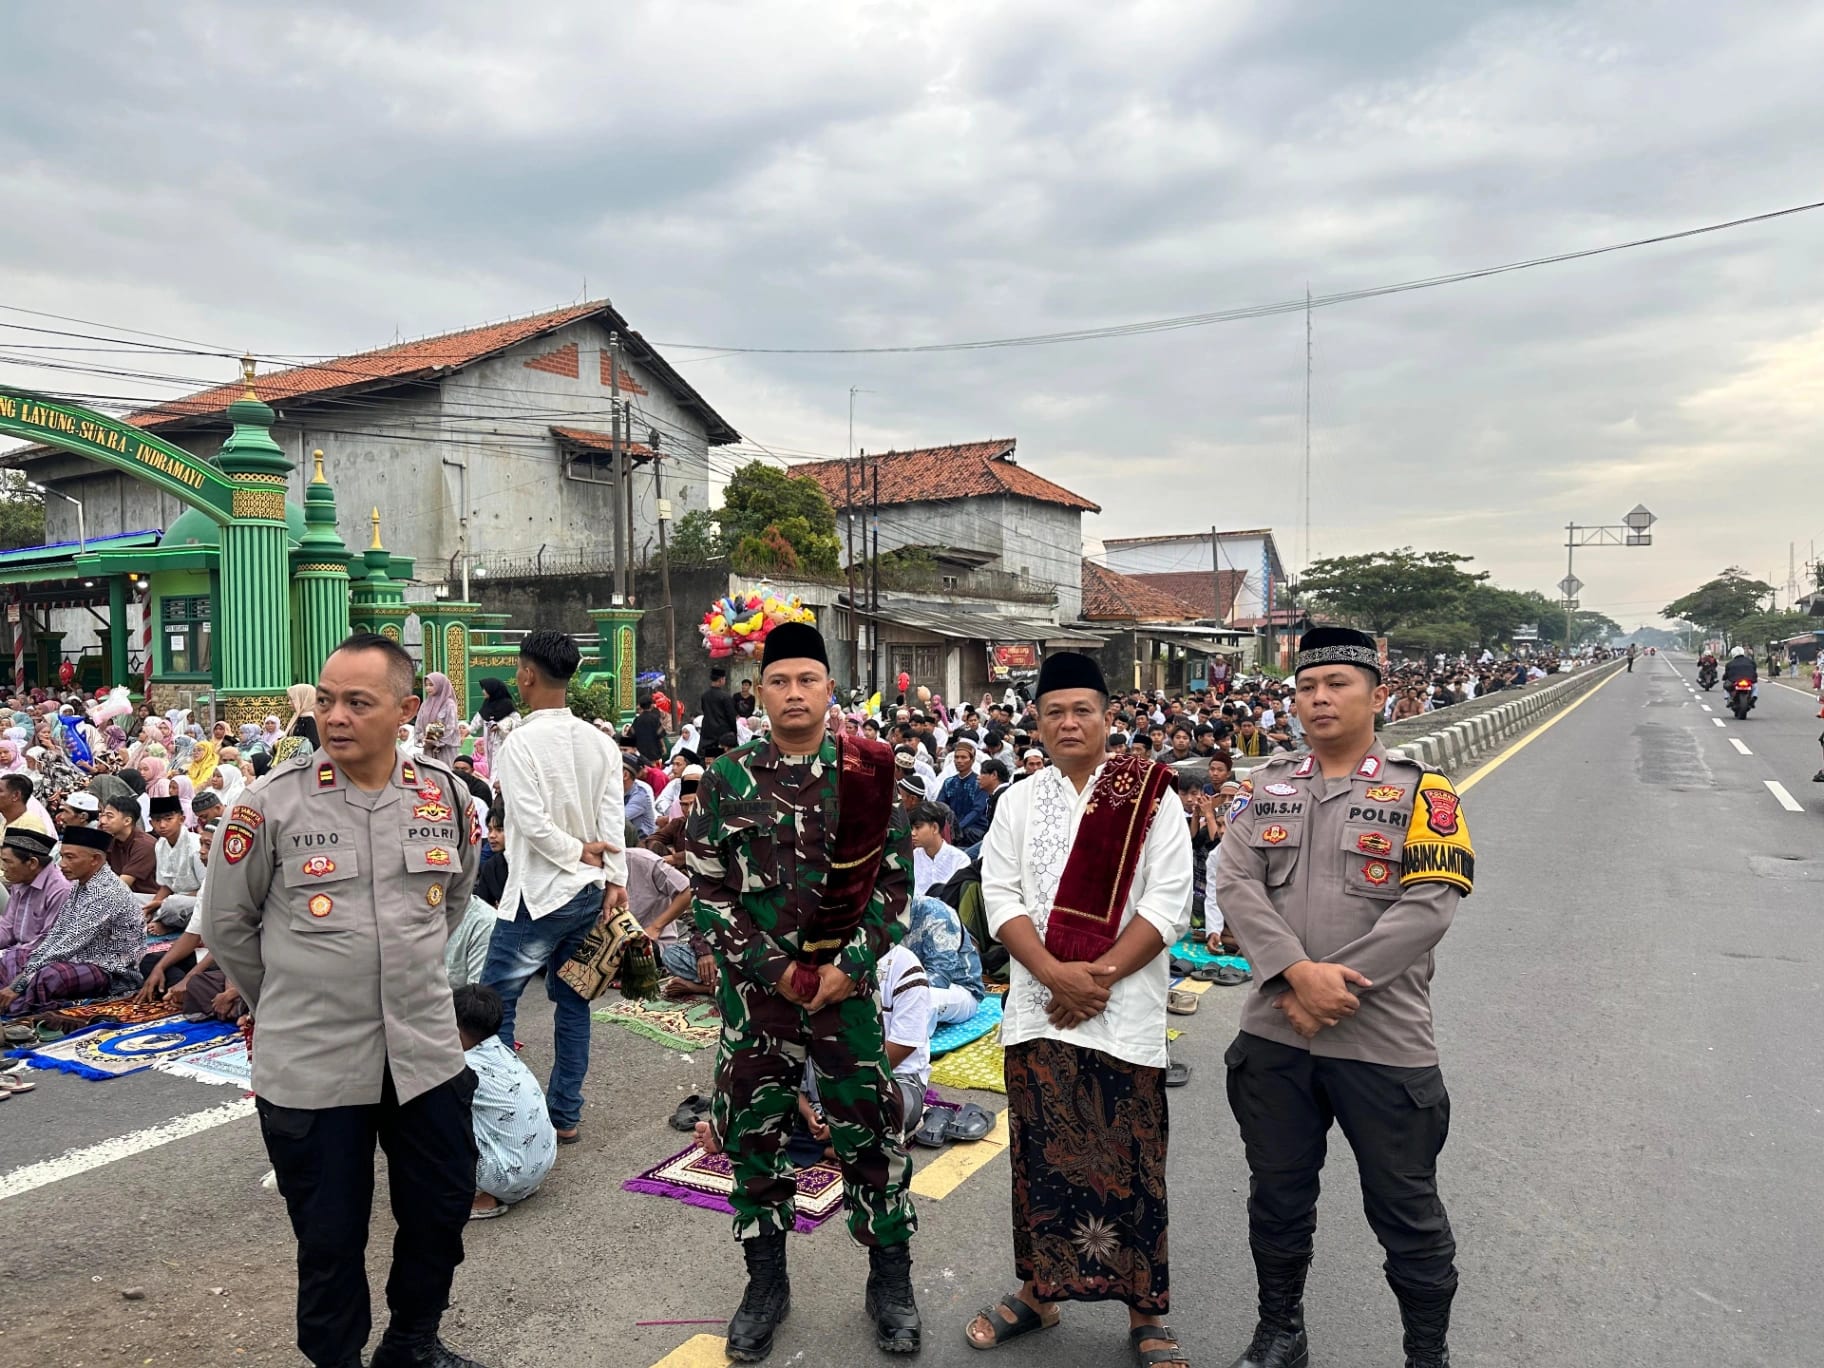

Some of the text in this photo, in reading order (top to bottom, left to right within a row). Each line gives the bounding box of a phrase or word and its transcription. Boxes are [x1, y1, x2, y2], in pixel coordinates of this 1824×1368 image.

[136, 443, 205, 489] INDRAMAYU
[1349, 807, 1408, 827] POLRI
[292, 832, 339, 848] YUDO
[408, 827, 453, 840] POLRI
